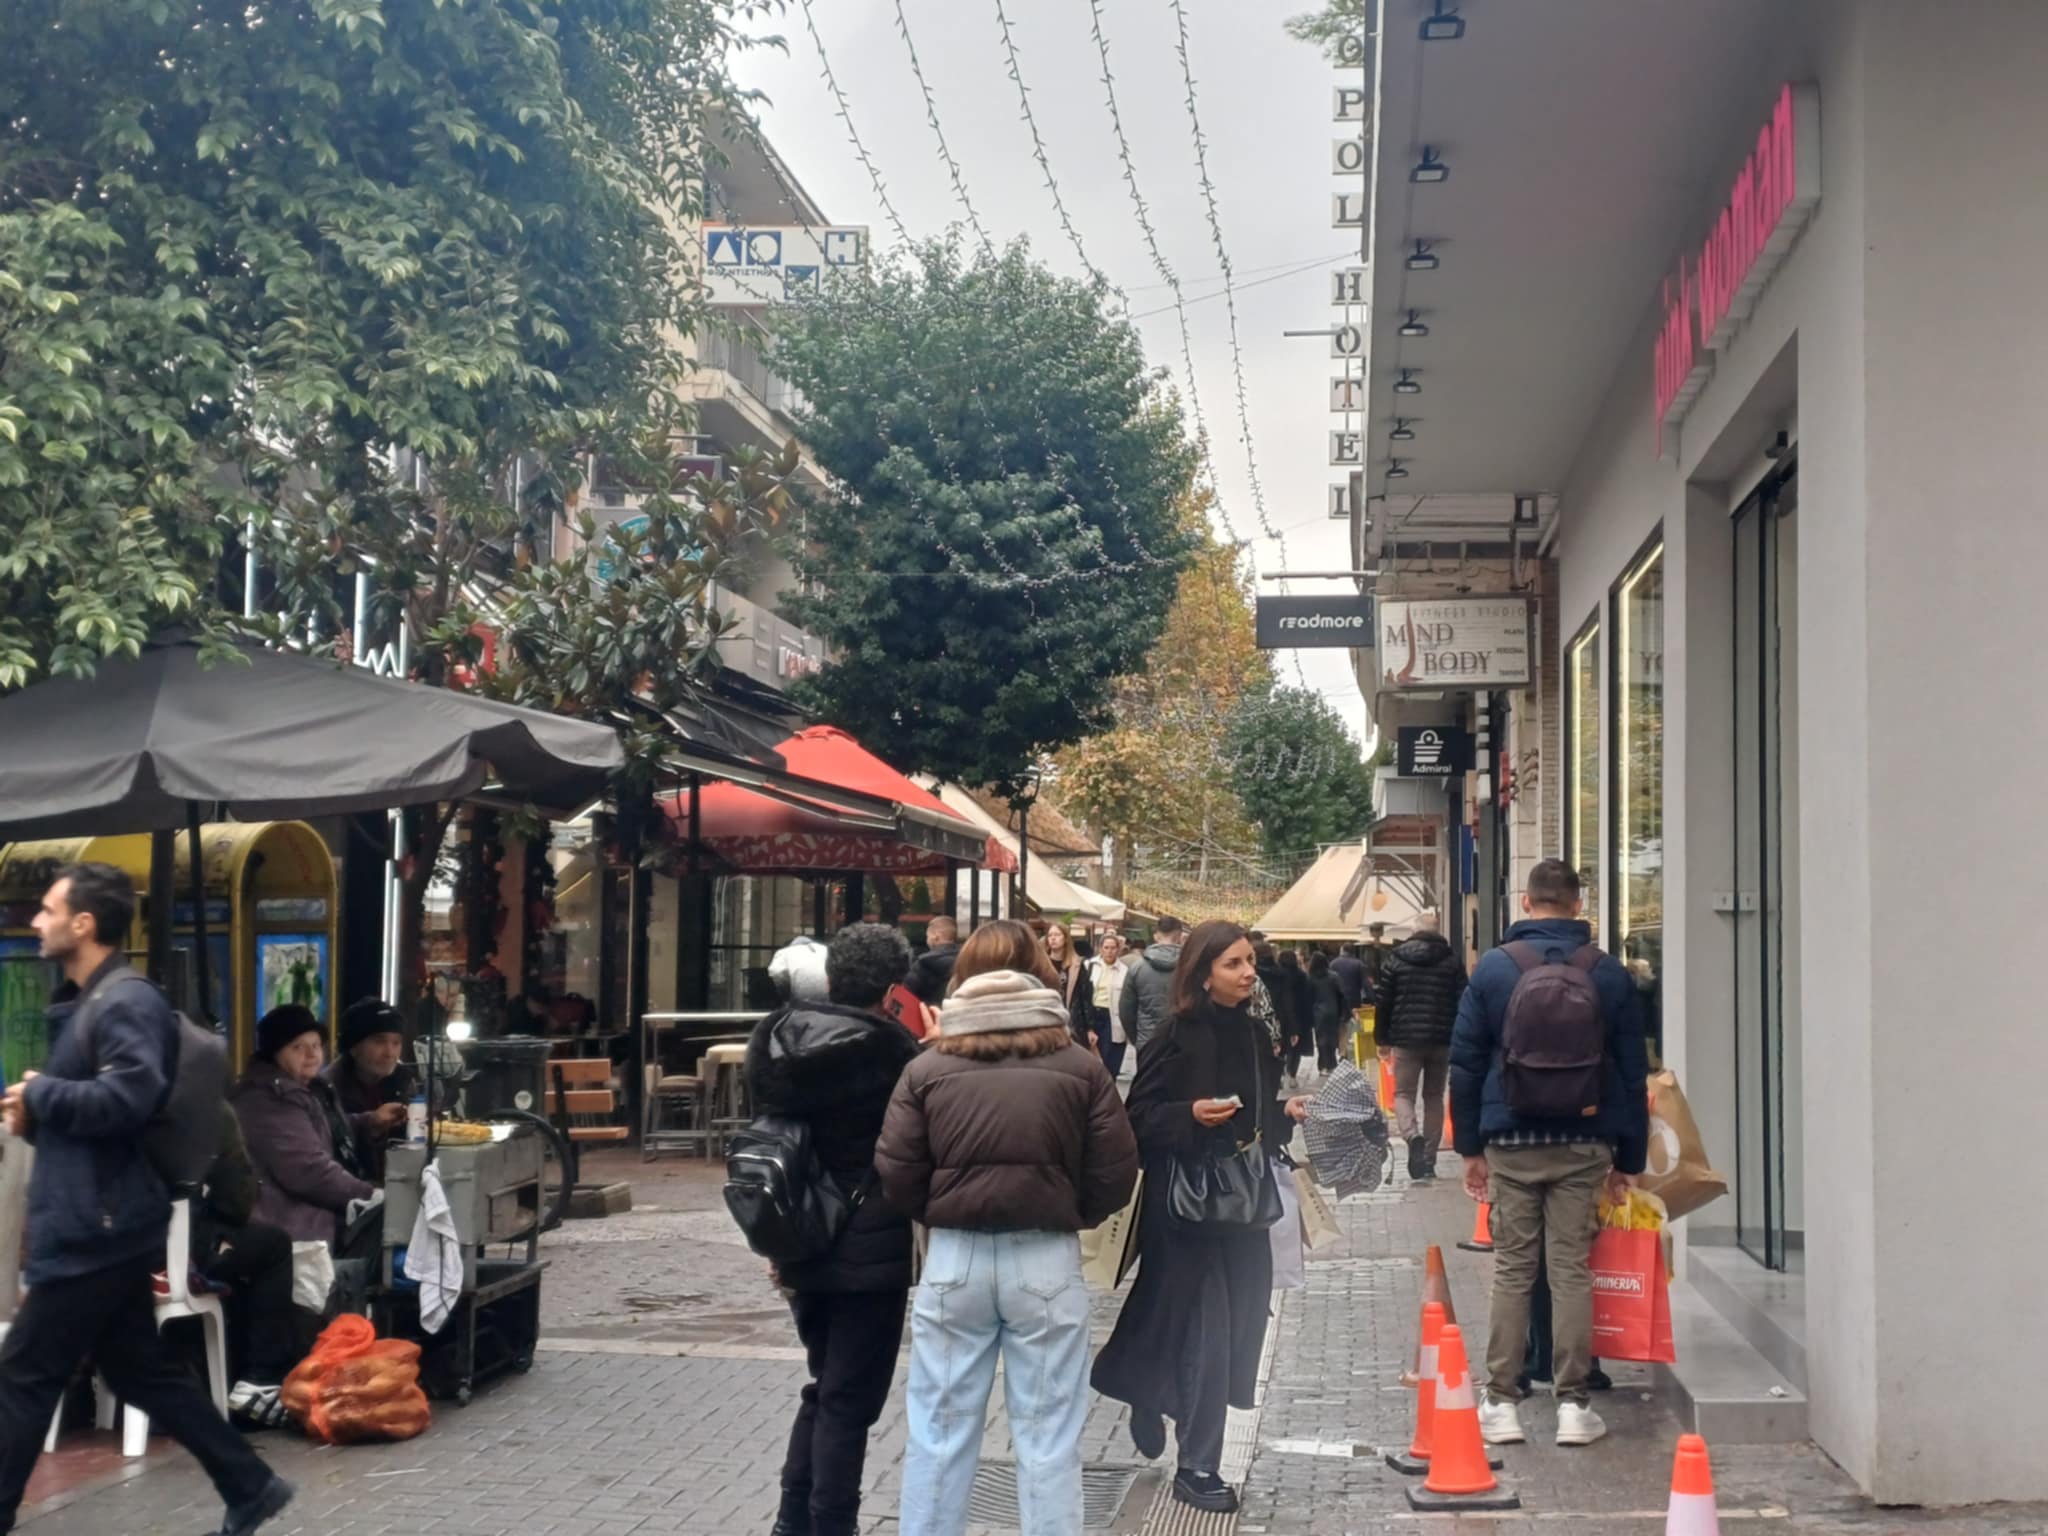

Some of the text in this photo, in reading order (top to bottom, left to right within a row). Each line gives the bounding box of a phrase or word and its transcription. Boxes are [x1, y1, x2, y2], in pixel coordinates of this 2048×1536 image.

[1279, 613, 1364, 629] readmore
[1423, 651, 1493, 675] BODY
[1412, 764, 1453, 774] Admiral
